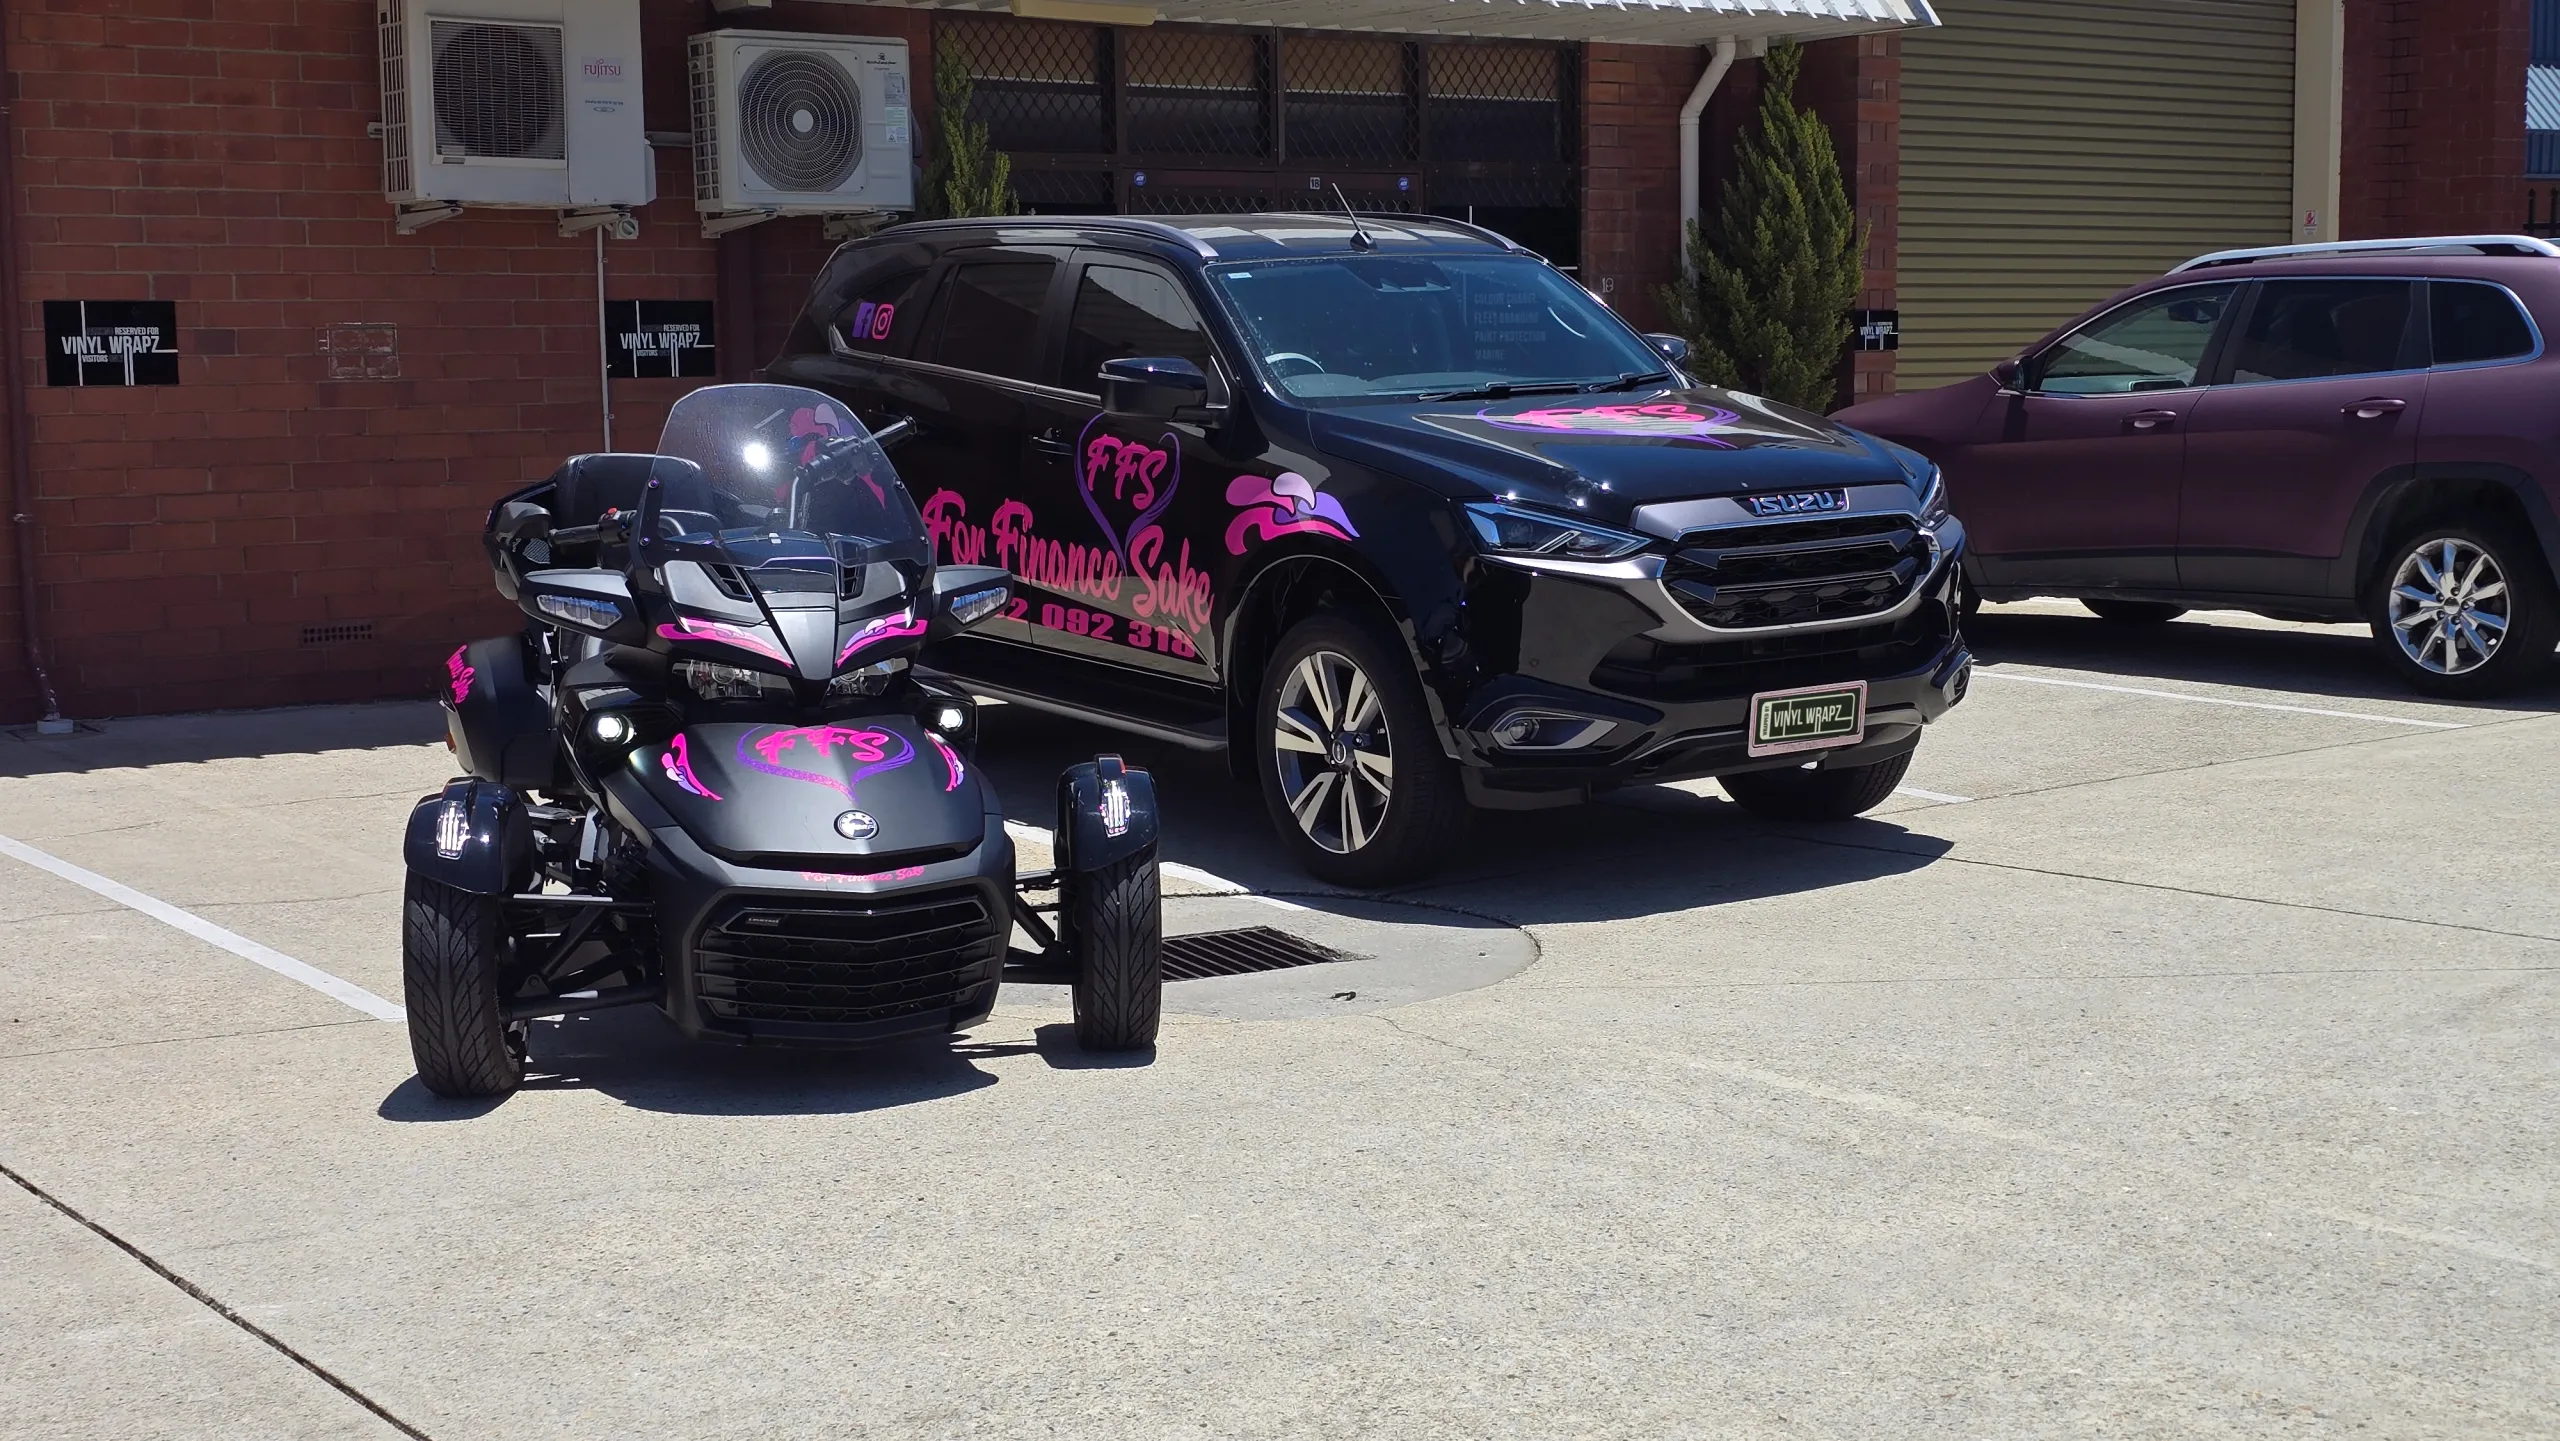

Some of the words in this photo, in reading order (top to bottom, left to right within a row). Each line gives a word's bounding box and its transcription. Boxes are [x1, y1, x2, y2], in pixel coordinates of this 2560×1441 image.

[584, 58, 621, 78] FUJITSU
[1311, 178, 1320, 189] 18
[1602, 277, 1614, 293] 18
[114, 327, 146, 335] RESERVED
[147, 327, 160, 335] FOR
[663, 324, 690, 332] RESERVED
[690, 324, 700, 332] FOR
[82, 354, 108, 363] VISITORS
[637, 349, 659, 357] VISITORS
[1513, 403, 1706, 430] FFS
[1087, 433, 1167, 510] FFS
[1749, 491, 1835, 515] ISUZU
[922, 487, 986, 566] For
[991, 498, 1123, 601] Finance
[1130, 525, 1214, 634] Sake
[1042, 603, 1114, 641] 092
[1128, 620, 1196, 658] 318
[1774, 709, 1803, 728] VINYL
[1806, 704, 1843, 725] WRAPZ
[755, 725, 890, 766] FFS
[801, 872, 831, 882] For
[834, 874, 893, 883] Finance
